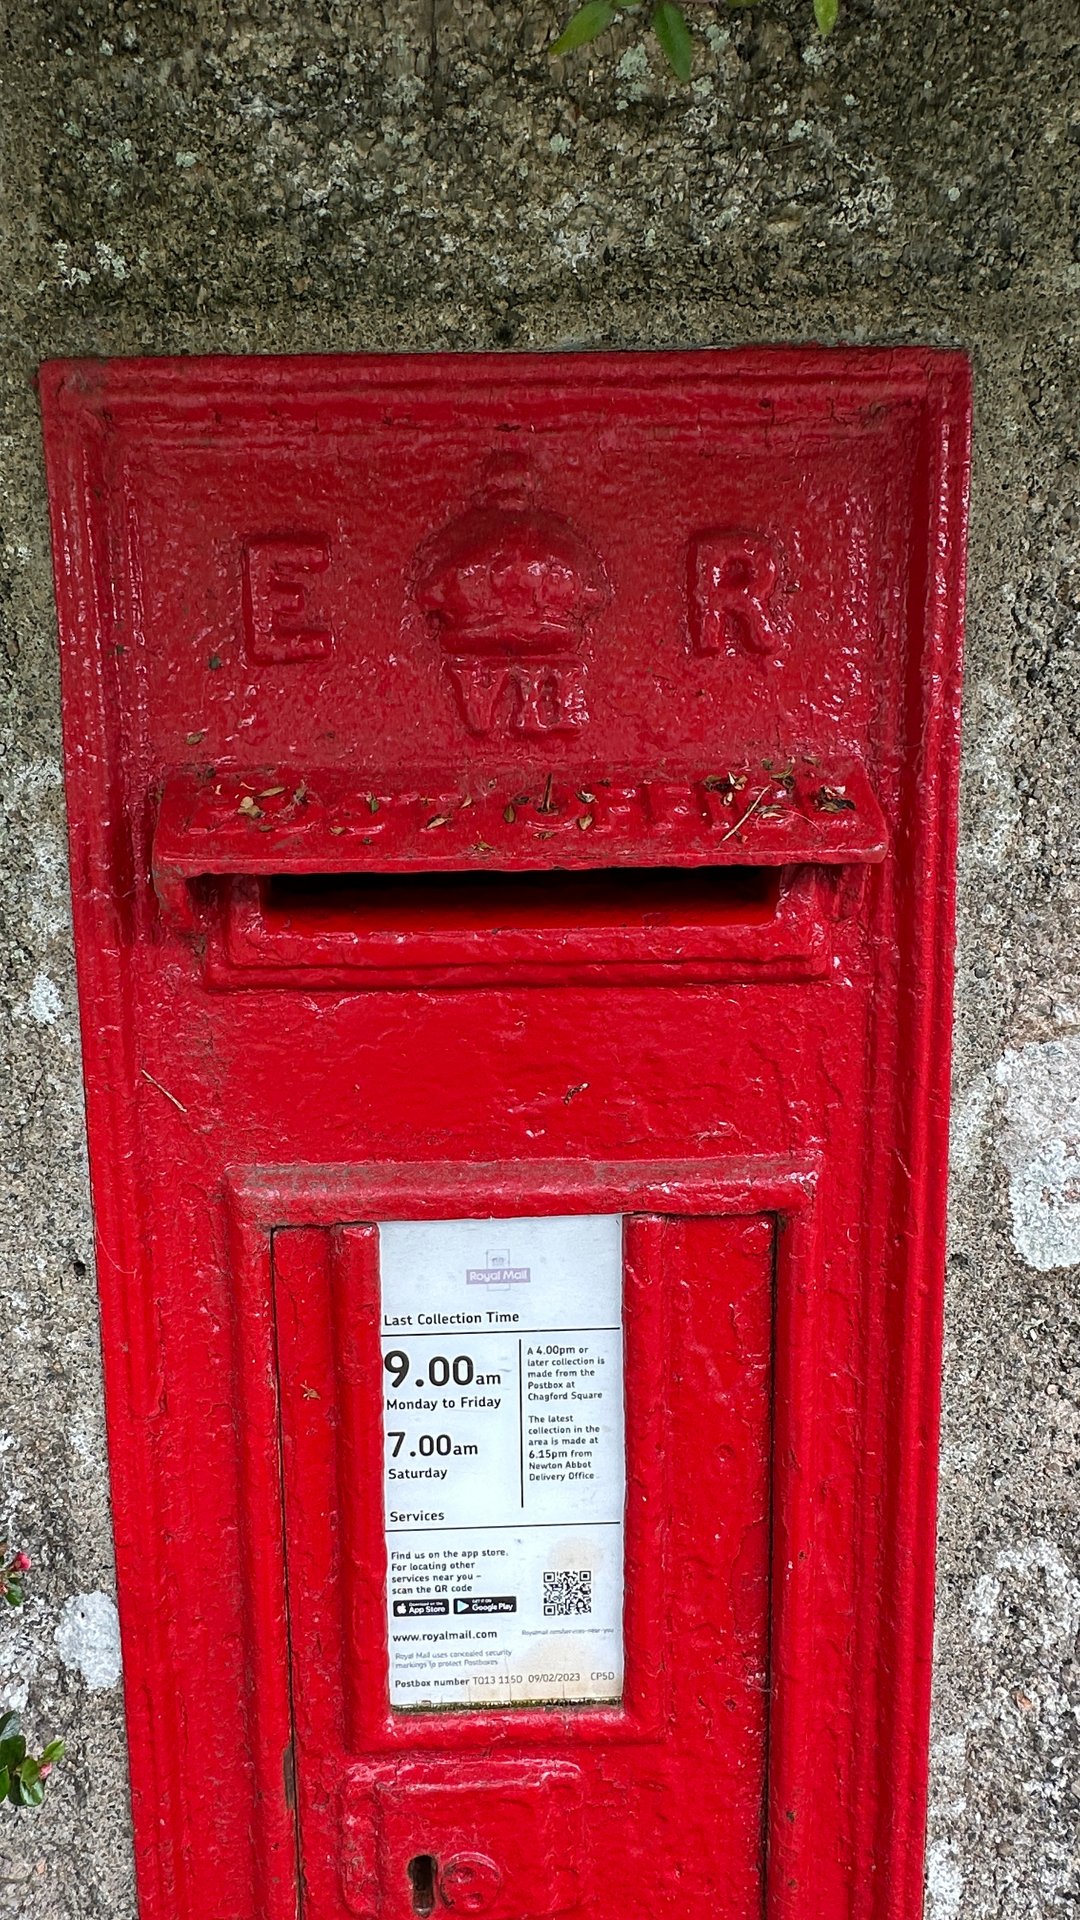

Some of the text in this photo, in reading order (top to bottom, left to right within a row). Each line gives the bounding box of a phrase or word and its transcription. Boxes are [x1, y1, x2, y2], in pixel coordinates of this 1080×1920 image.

[242, 527, 778, 664] E R
[469, 1270, 528, 1282] Royal Mail
[384, 1312, 519, 1326] Last Collection Time
[527, 1347, 533, 1355] A
[536, 1346, 575, 1356] 4.00pm
[527, 1357, 605, 1366] later collection is
[384, 1350, 501, 1388] 9.00am
[528, 1369, 552, 1378] made
[555, 1369, 577, 1377] from
[528, 1381, 563, 1389] Postbox
[528, 1391, 603, 1402] Chagford Square
[387, 1397, 501, 1411] Monday to Friday
[528, 1415, 545, 1423] The
[528, 1426, 571, 1434] collection
[585, 1425, 600, 1433] the
[387, 1432, 478, 1458] 7.00am
[528, 1438, 548, 1446] area
[551, 1437, 559, 1445] is
[562, 1437, 586, 1445] made
[529, 1449, 592, 1460] 6.15pm from
[529, 1461, 592, 1470] Newton Abbot
[389, 1469, 447, 1480] Saturday
[529, 1472, 594, 1482] Delivery Office
[390, 1511, 445, 1522] Services
[443, 1550, 459, 1558] the
[462, 1550, 478, 1558] app
[482, 1549, 508, 1557] store.
[392, 1563, 407, 1571] For
[410, 1562, 447, 1571] locating
[392, 1575, 430, 1583] services
[456, 1574, 474, 1582] you
[435, 1585, 448, 1593] QR
[451, 1584, 472, 1592] code
[409, 1606, 425, 1614] App
[472, 1602, 513, 1612] Google Play
[392, 1630, 498, 1642] www.royalmail.com
[416, 1651, 430, 1659] Mail
[486, 1649, 512, 1658] security
[395, 1661, 427, 1670] markings
[438, 1659, 462, 1668] protect
[464, 1658, 498, 1666] Postboxes
[395, 1680, 431, 1688] Postbox
[435, 1678, 469, 1687] number
[528, 1673, 580, 1683] 09/02/2023
